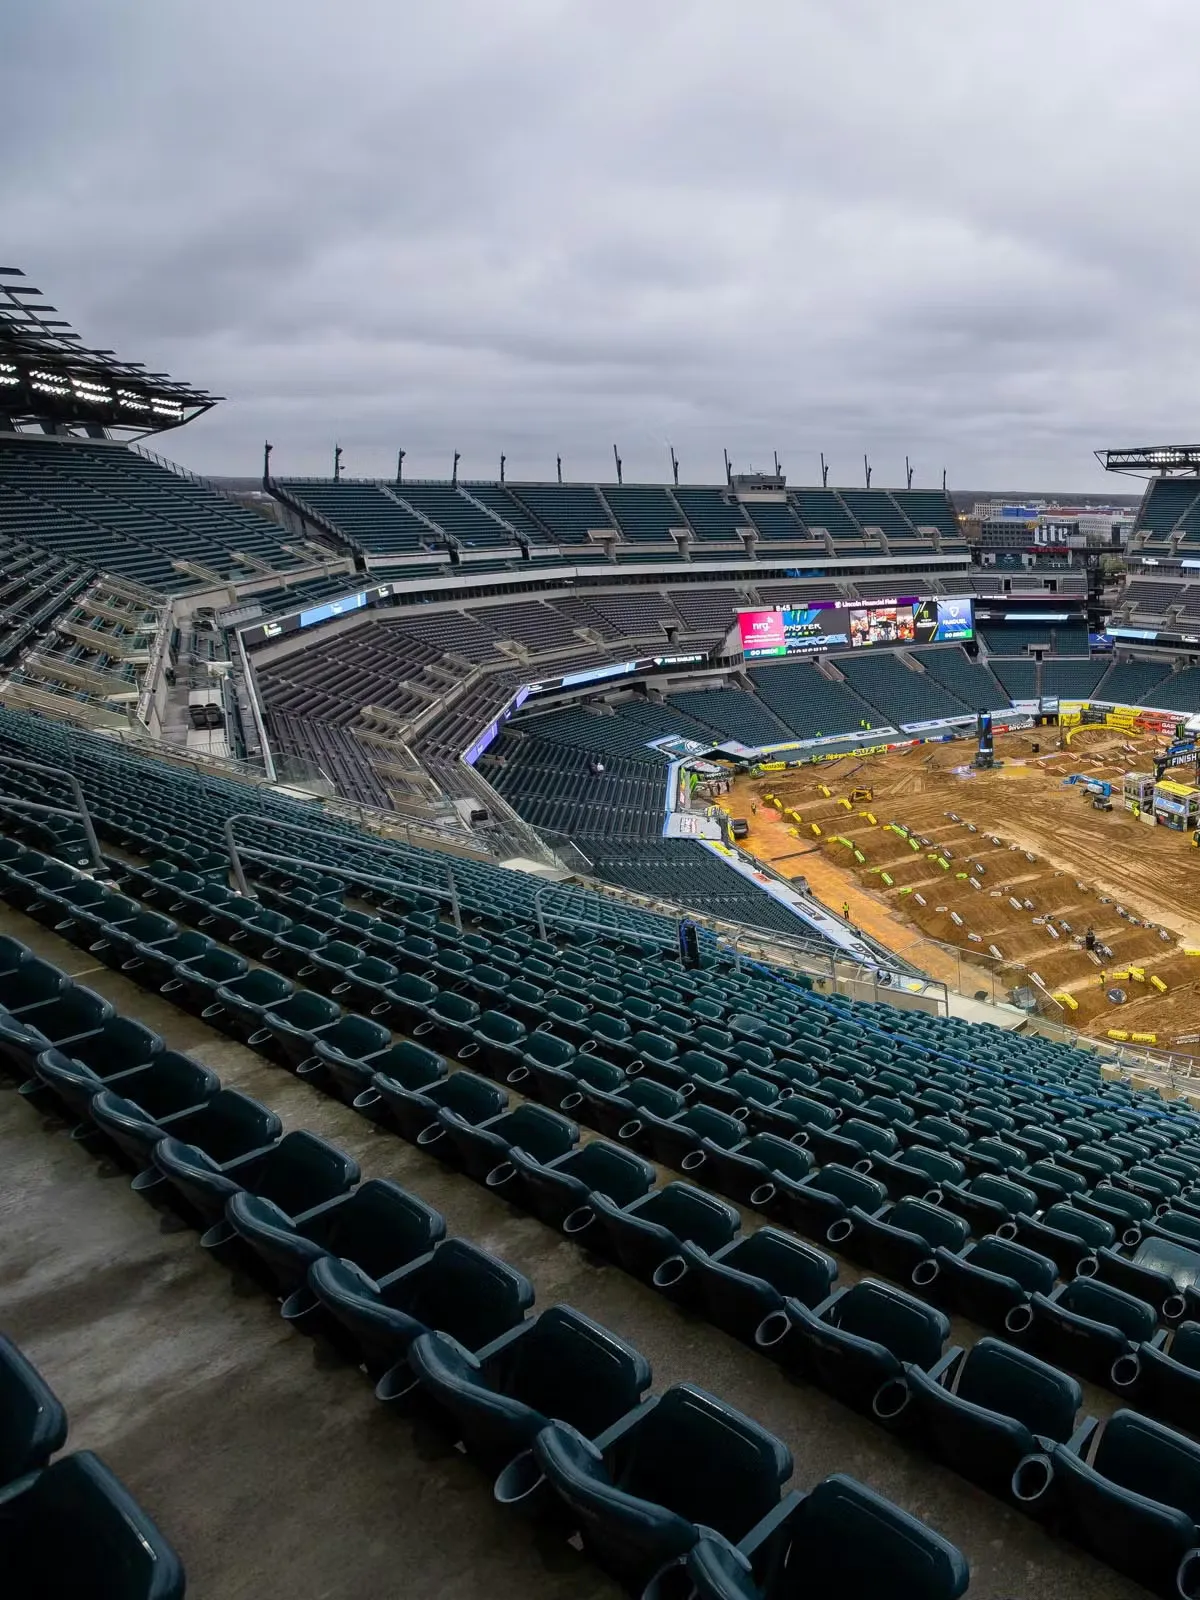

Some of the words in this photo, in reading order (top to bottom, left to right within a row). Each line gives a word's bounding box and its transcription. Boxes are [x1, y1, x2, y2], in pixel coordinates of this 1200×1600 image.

[1034, 525, 1068, 546] Lite
[753, 622, 769, 631] nrg
[1172, 753, 1197, 766] FINISH
